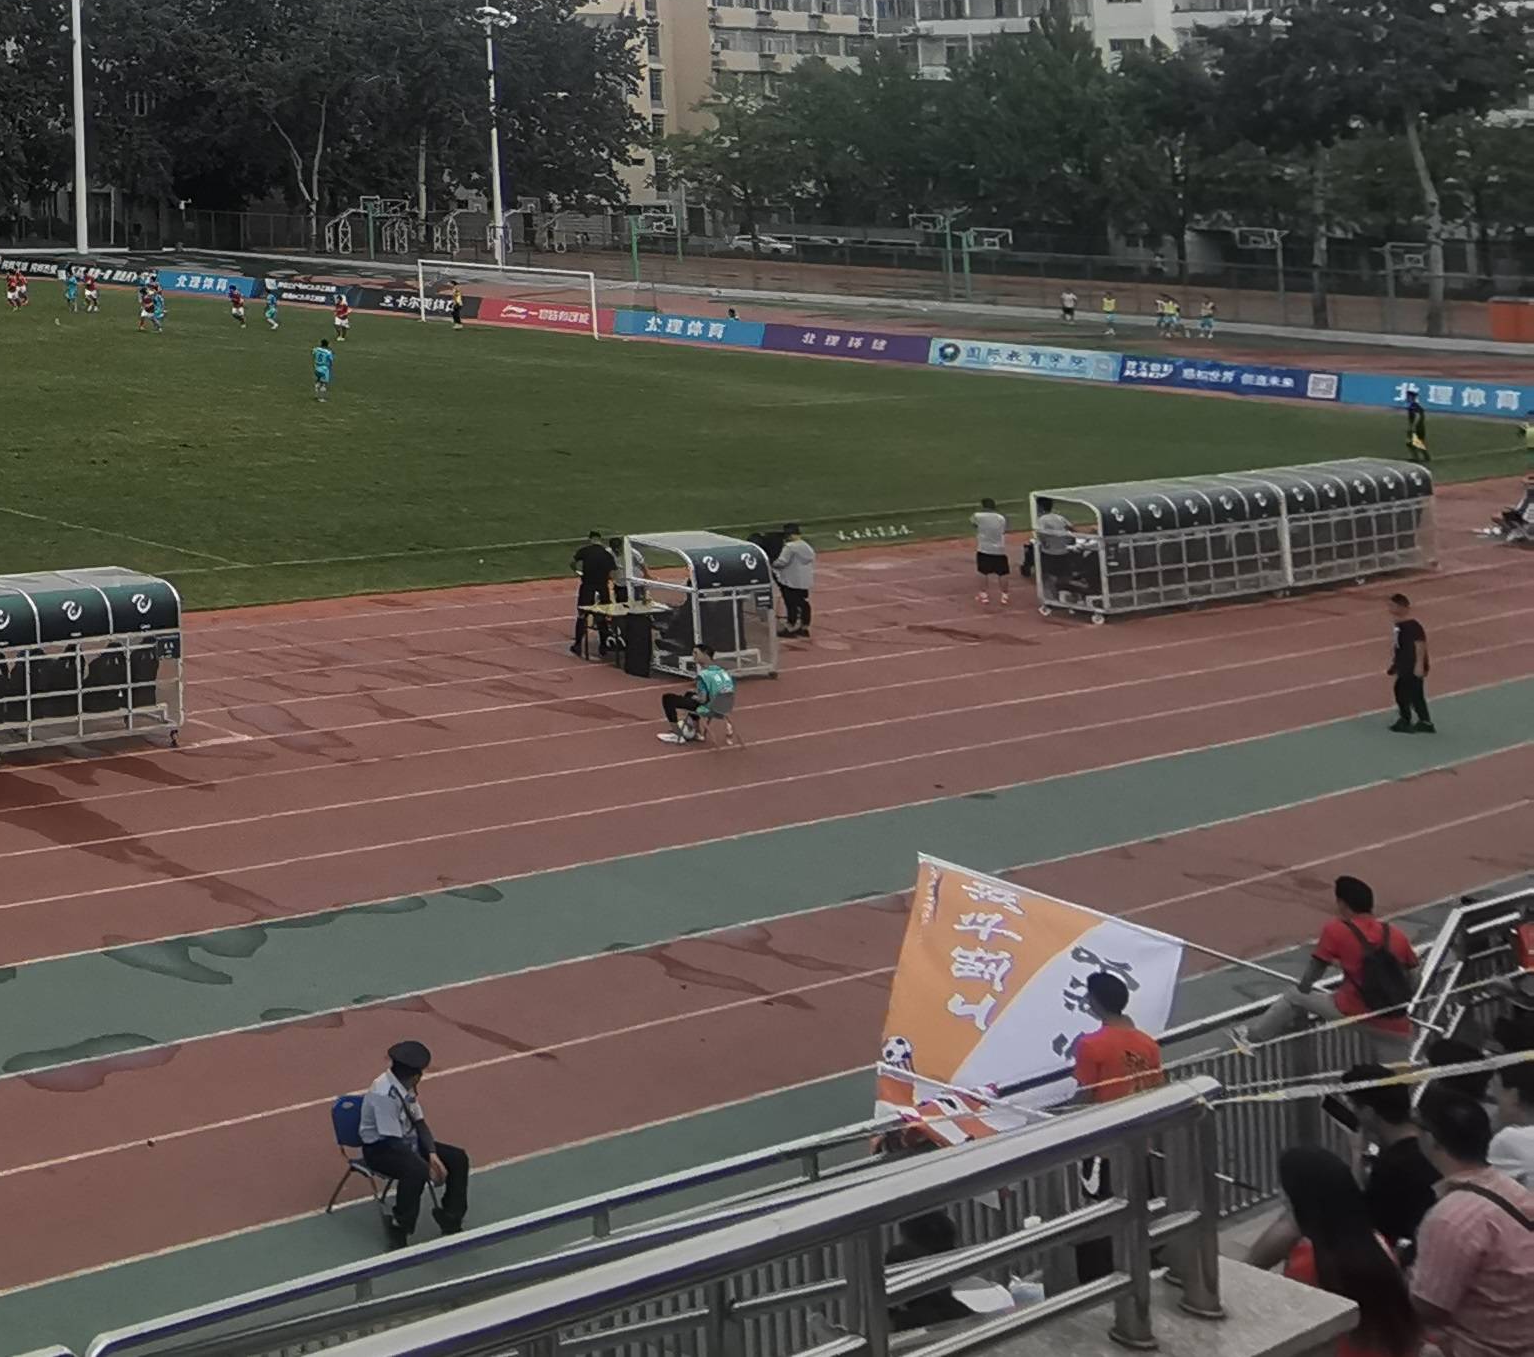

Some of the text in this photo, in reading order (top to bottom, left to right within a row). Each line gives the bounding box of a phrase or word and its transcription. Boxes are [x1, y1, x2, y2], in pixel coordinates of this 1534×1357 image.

[644, 315, 727, 339] 北理体育
[1395, 382, 1522, 411] 北理体育
